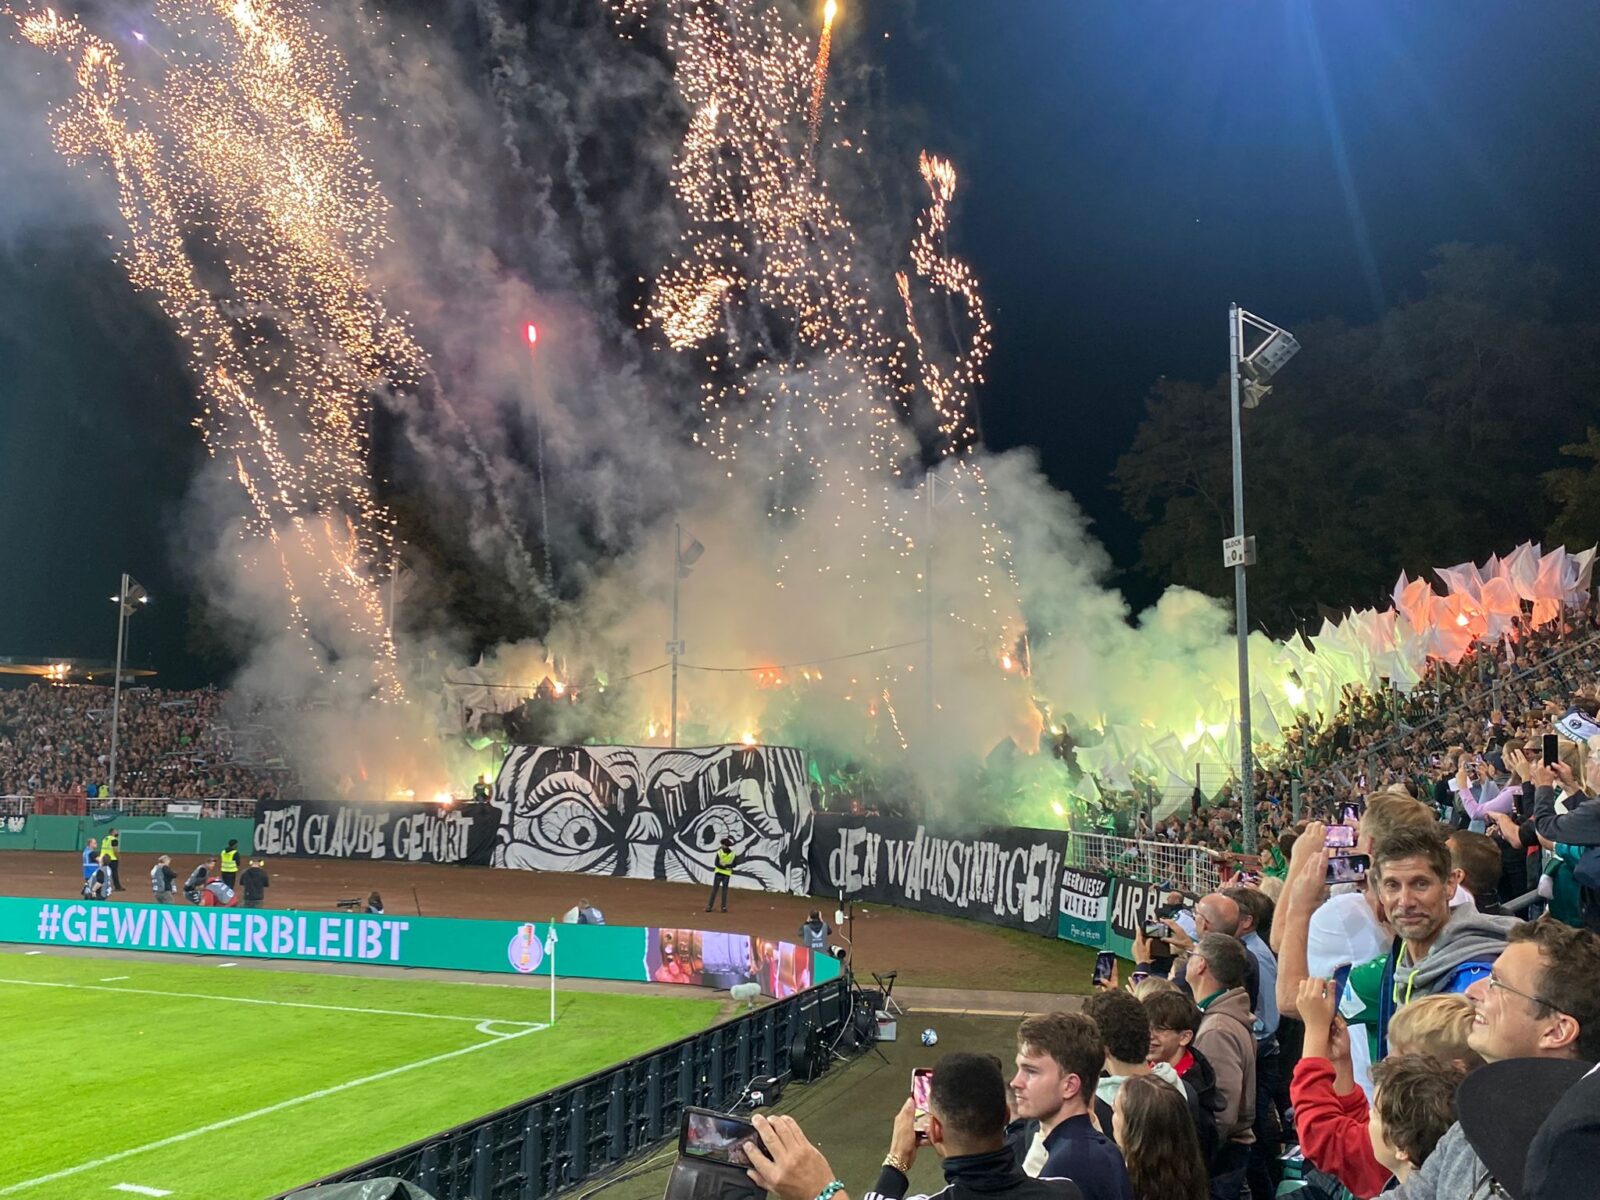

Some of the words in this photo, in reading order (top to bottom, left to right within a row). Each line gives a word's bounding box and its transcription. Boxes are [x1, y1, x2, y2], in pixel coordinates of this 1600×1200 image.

[303, 806, 390, 858] GLAUBE
[885, 825, 1060, 923] WAHNSINNIGEN
[37, 903, 409, 961] #GEWINNERBLEIBT
[1064, 894, 1099, 918] ULTRAS
[1111, 883, 1143, 930] AIR
